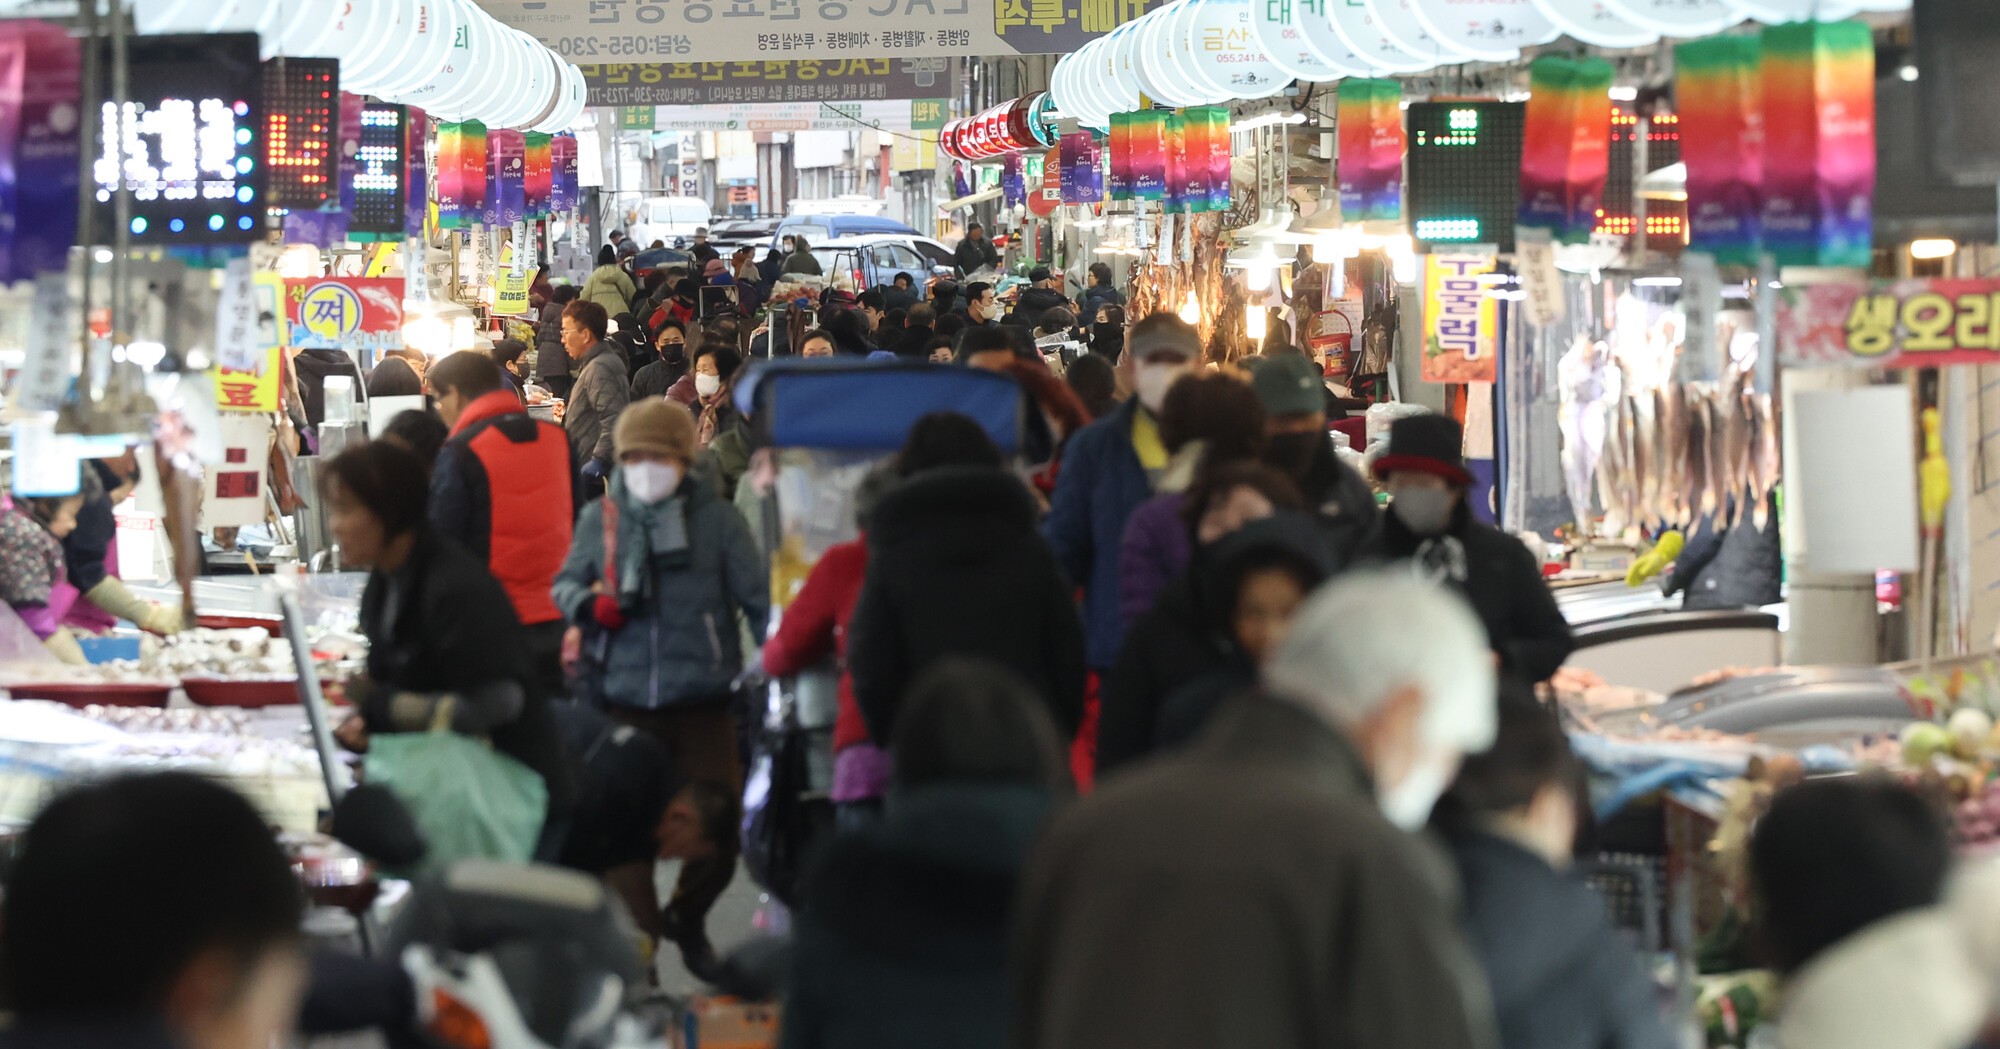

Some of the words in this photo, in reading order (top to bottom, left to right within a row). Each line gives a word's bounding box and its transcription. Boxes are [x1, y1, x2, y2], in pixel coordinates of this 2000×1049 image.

[1202, 27, 1253, 51] 금산
[311, 293, 344, 333] 쪄
[1846, 292, 2000, 356] 생오리
